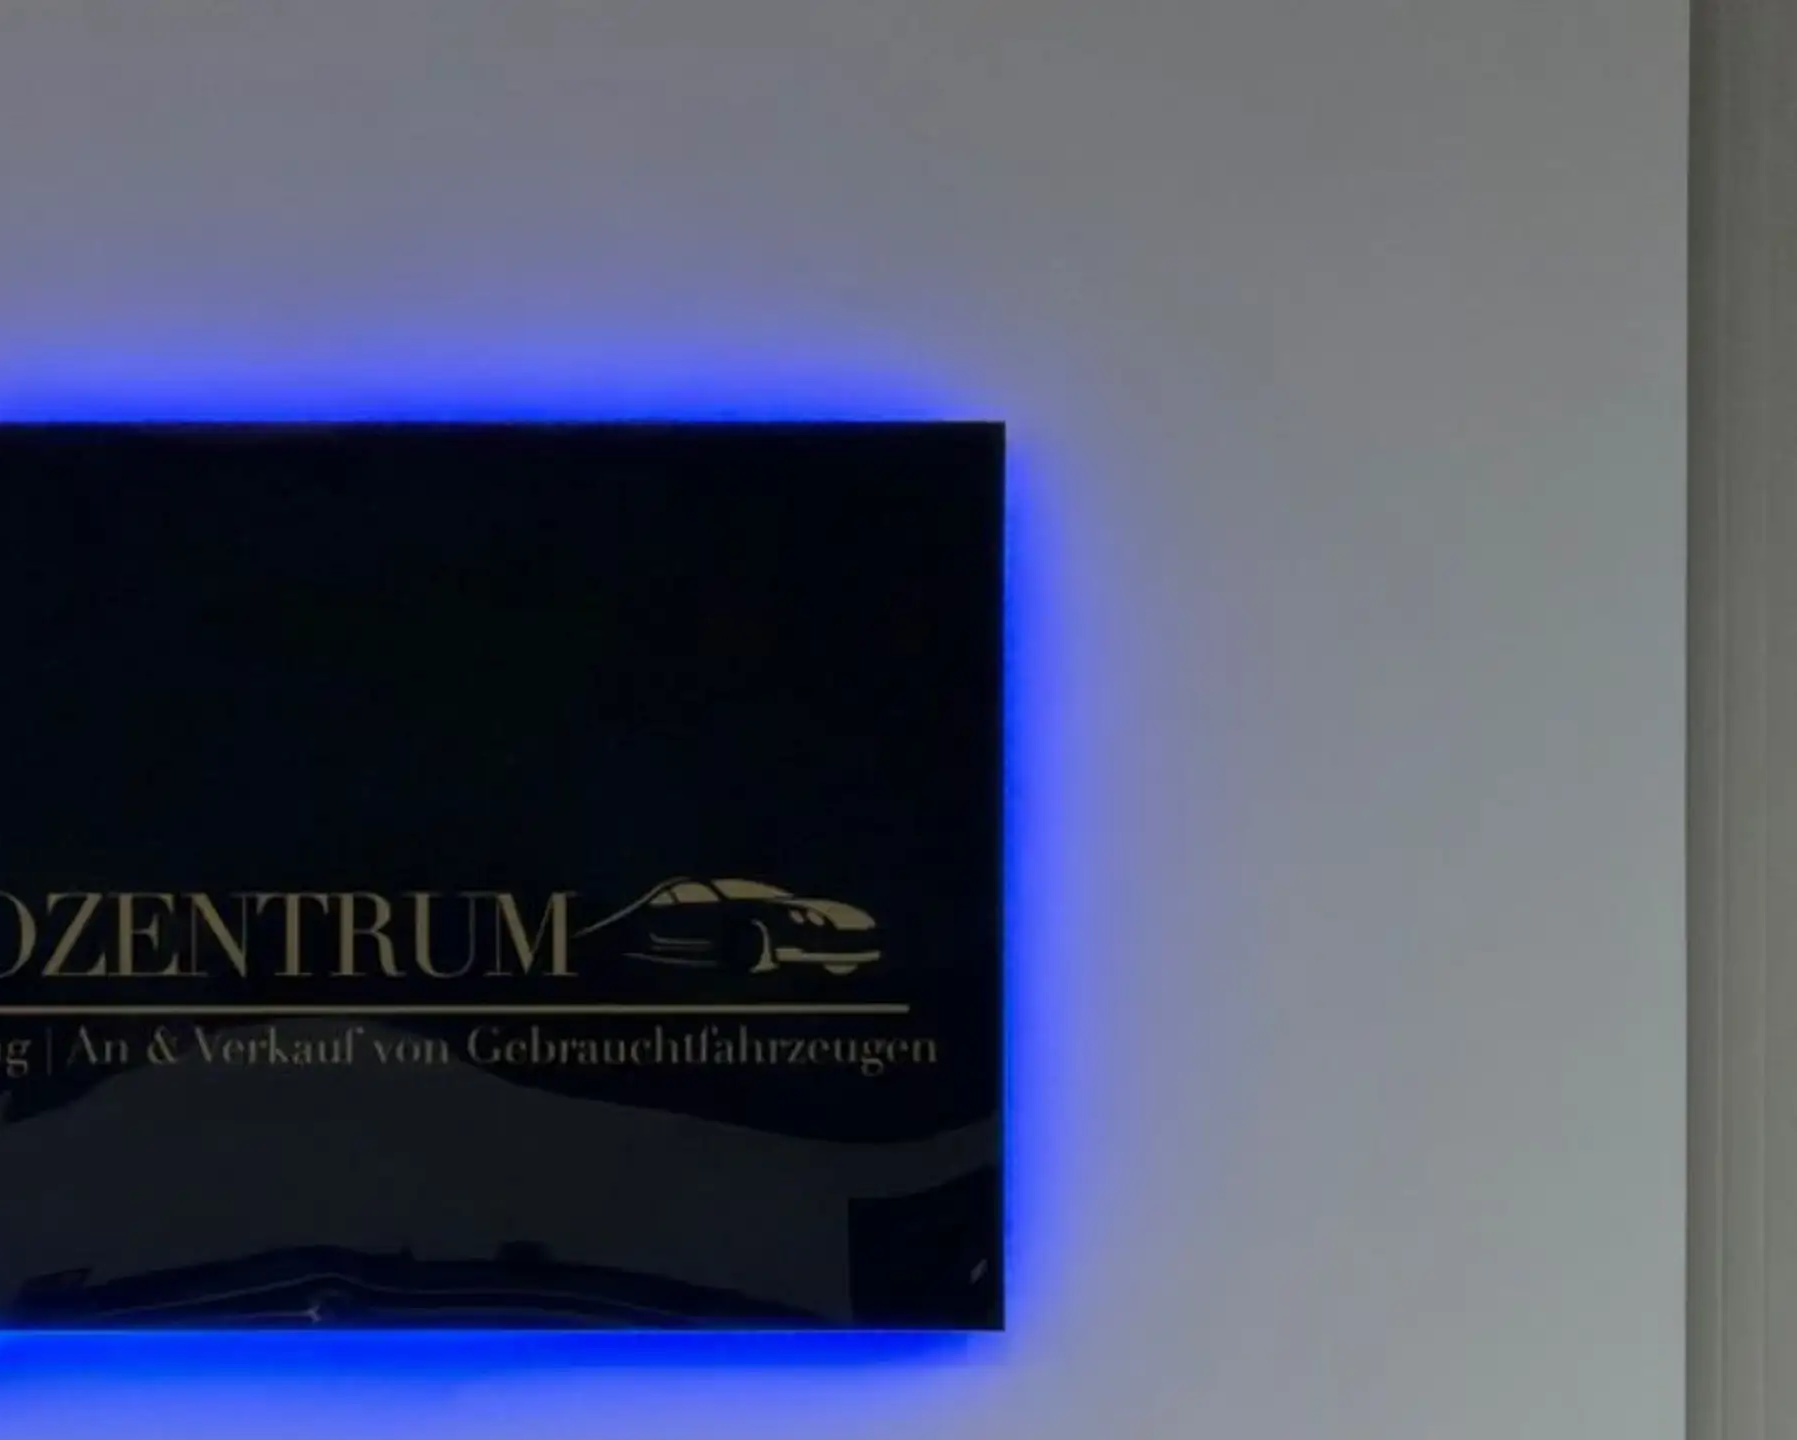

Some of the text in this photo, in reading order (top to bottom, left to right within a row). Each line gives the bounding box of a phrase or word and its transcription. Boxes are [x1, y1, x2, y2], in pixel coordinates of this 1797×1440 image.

[67, 1024, 130, 1065] An
[146, 1024, 178, 1065] &
[194, 1024, 365, 1065] Verkauf
[372, 1036, 450, 1065] von
[465, 1023, 939, 1077] Gebrauchtfahrzeugen
